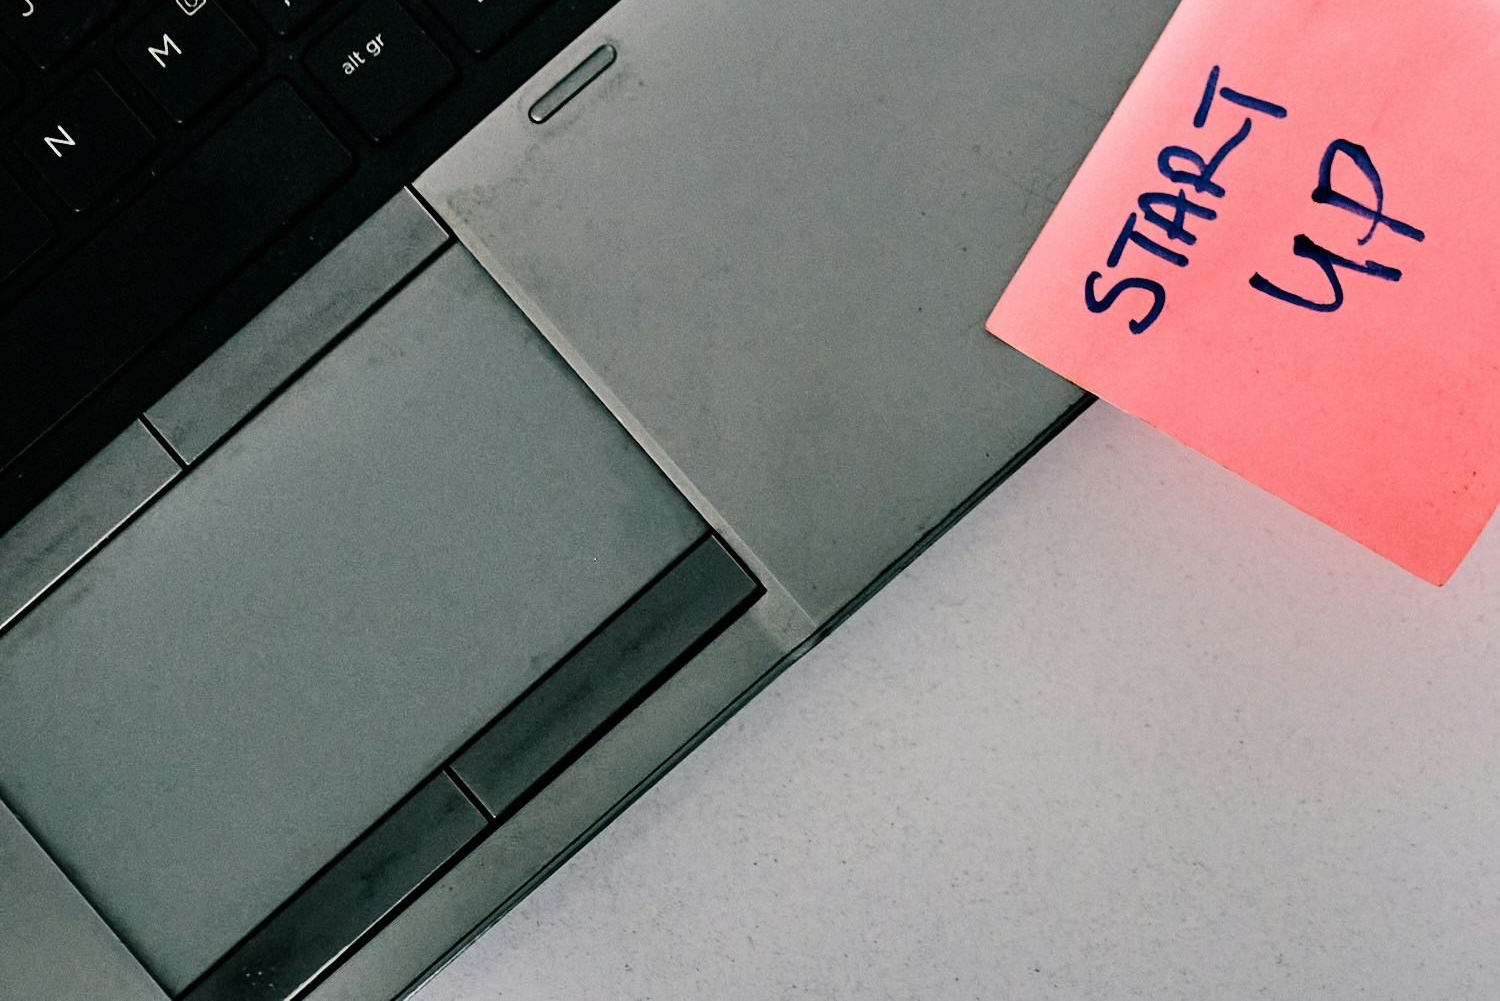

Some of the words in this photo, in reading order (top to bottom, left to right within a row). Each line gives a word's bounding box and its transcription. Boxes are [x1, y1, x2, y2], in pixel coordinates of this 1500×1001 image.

[148, 34, 181, 68] M
[341, 49, 367, 76] alt
[365, 32, 386, 58] gr
[44, 126, 75, 157] N
[1084, 65, 1288, 335] START
[1248, 138, 1426, 312] UP
